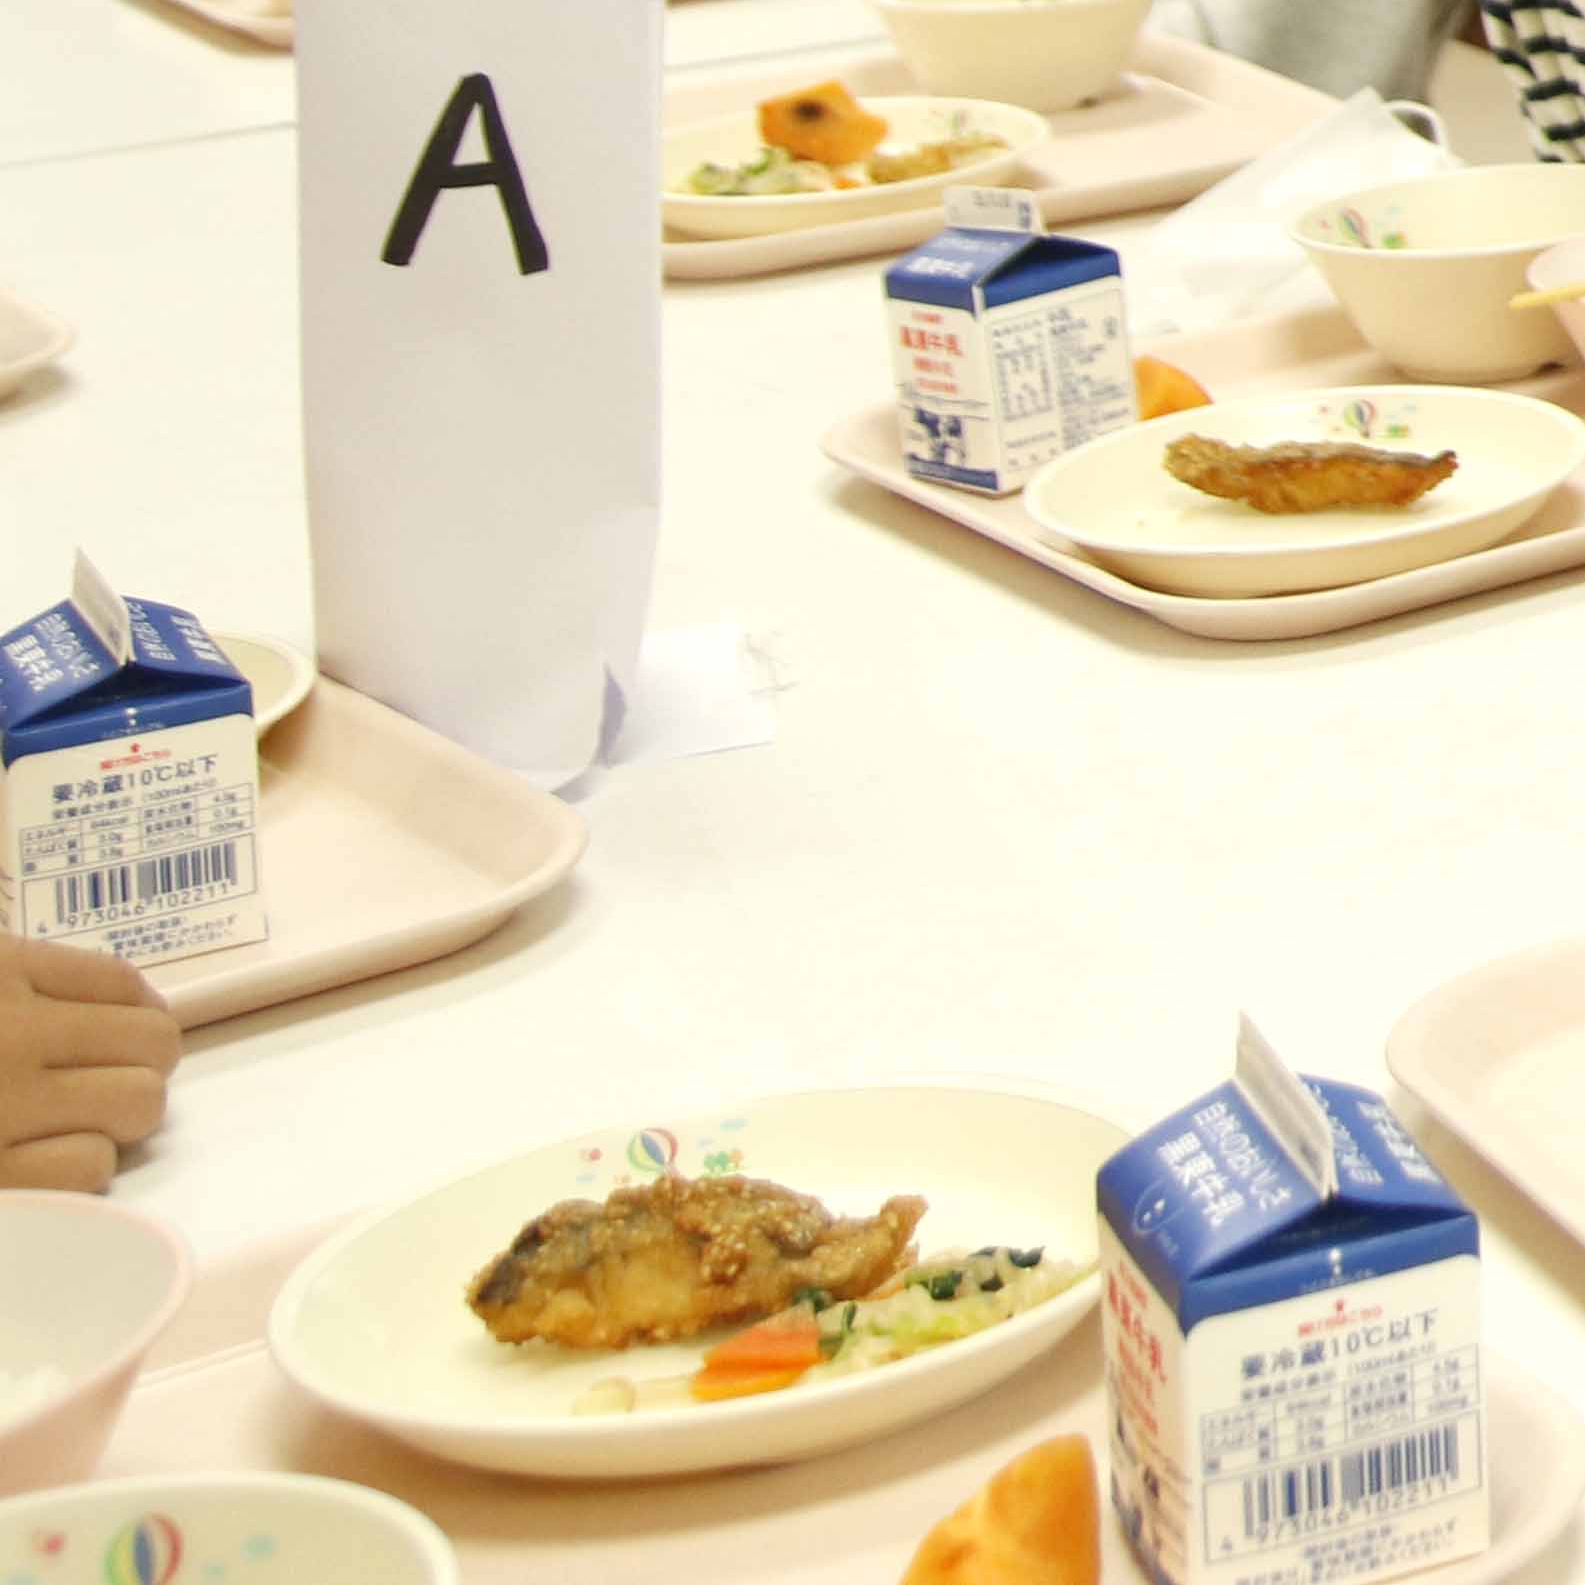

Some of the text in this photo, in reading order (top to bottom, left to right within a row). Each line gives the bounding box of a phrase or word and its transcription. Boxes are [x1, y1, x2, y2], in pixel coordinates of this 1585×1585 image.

[381, 72, 550, 276] A
[66, 904, 145, 928] 973046
[156, 883, 228, 909] 102211
[1363, 1481, 1449, 1515] 102211
